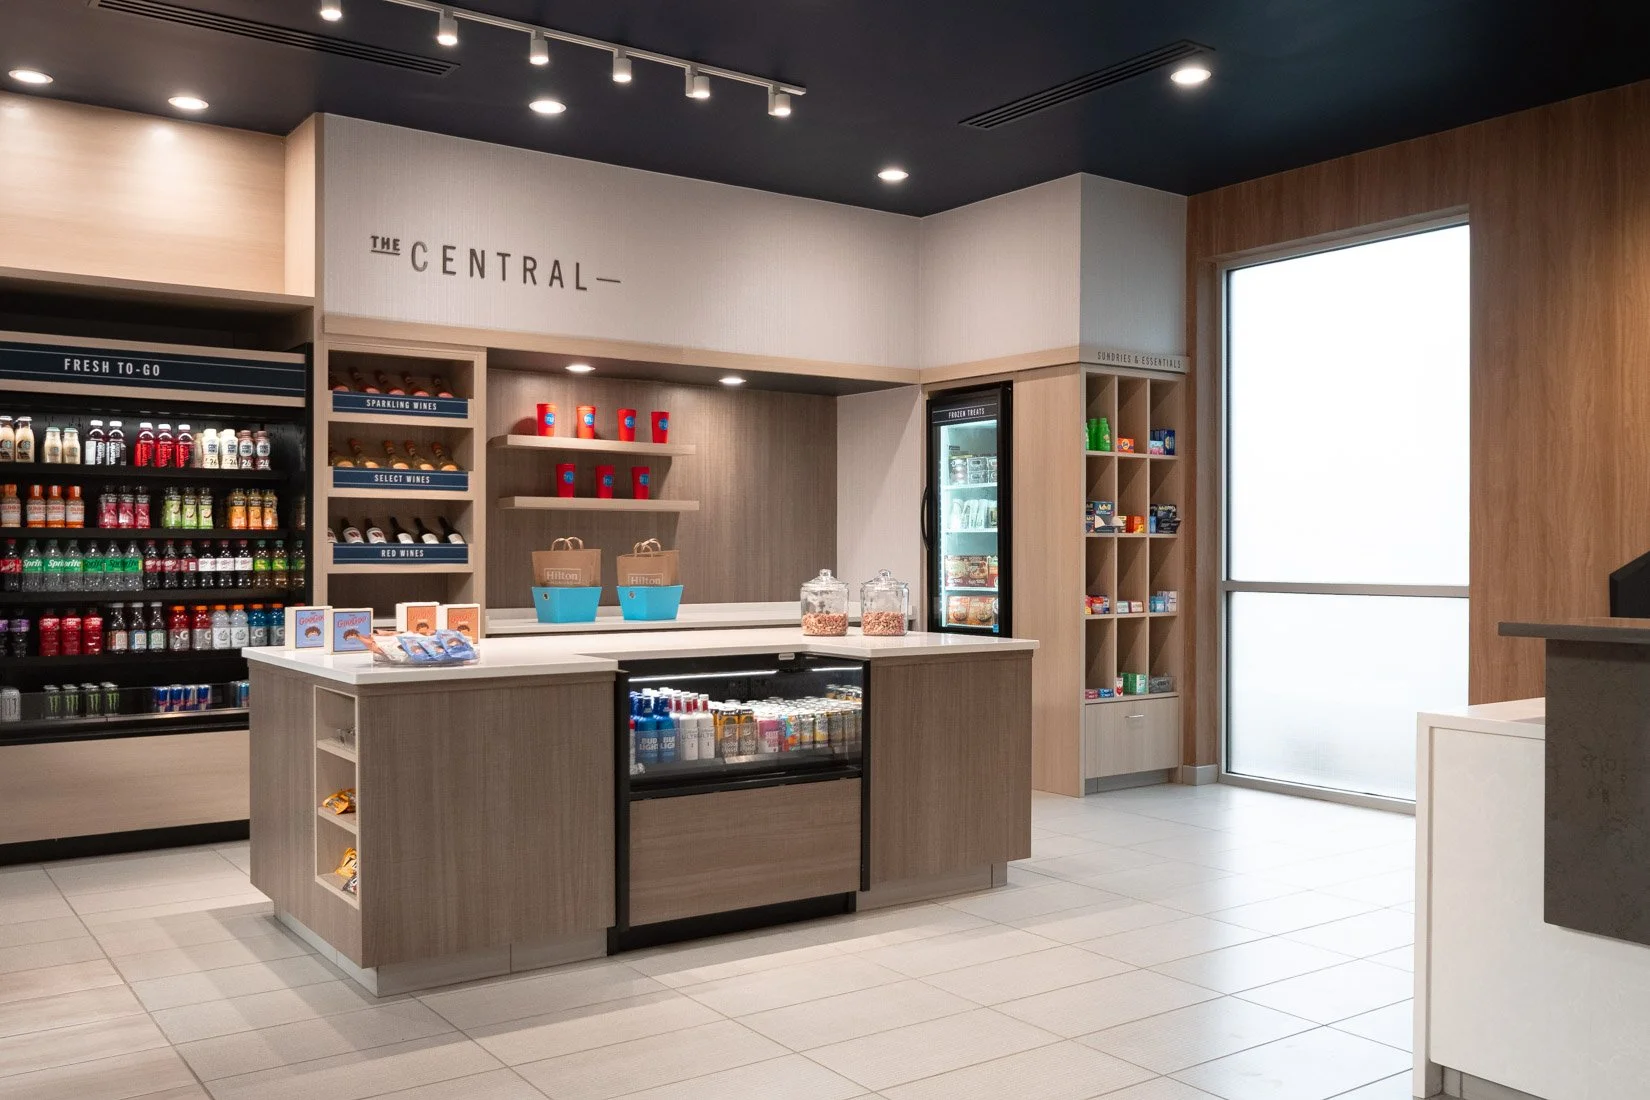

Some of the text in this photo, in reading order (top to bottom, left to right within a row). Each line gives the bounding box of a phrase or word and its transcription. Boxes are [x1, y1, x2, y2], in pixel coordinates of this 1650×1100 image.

[371, 236, 587, 291] THE CENTRAL
[1097, 351, 1181, 369] SUNDRIES & ESSENTIALS
[64, 358, 160, 377] FRESH TO-GO
[366, 399, 437, 411] SPARKLING WINES
[948, 407, 985, 419] FROZEN TREATS
[374, 474, 430, 484] SELECT WINES
[381, 549, 424, 558] RED WINES
[23, 559, 42, 568] Sprit
[48, 559, 64, 568] Spri
[546, 571, 578, 580] Hilton
[630, 576, 661, 585] Hilton
